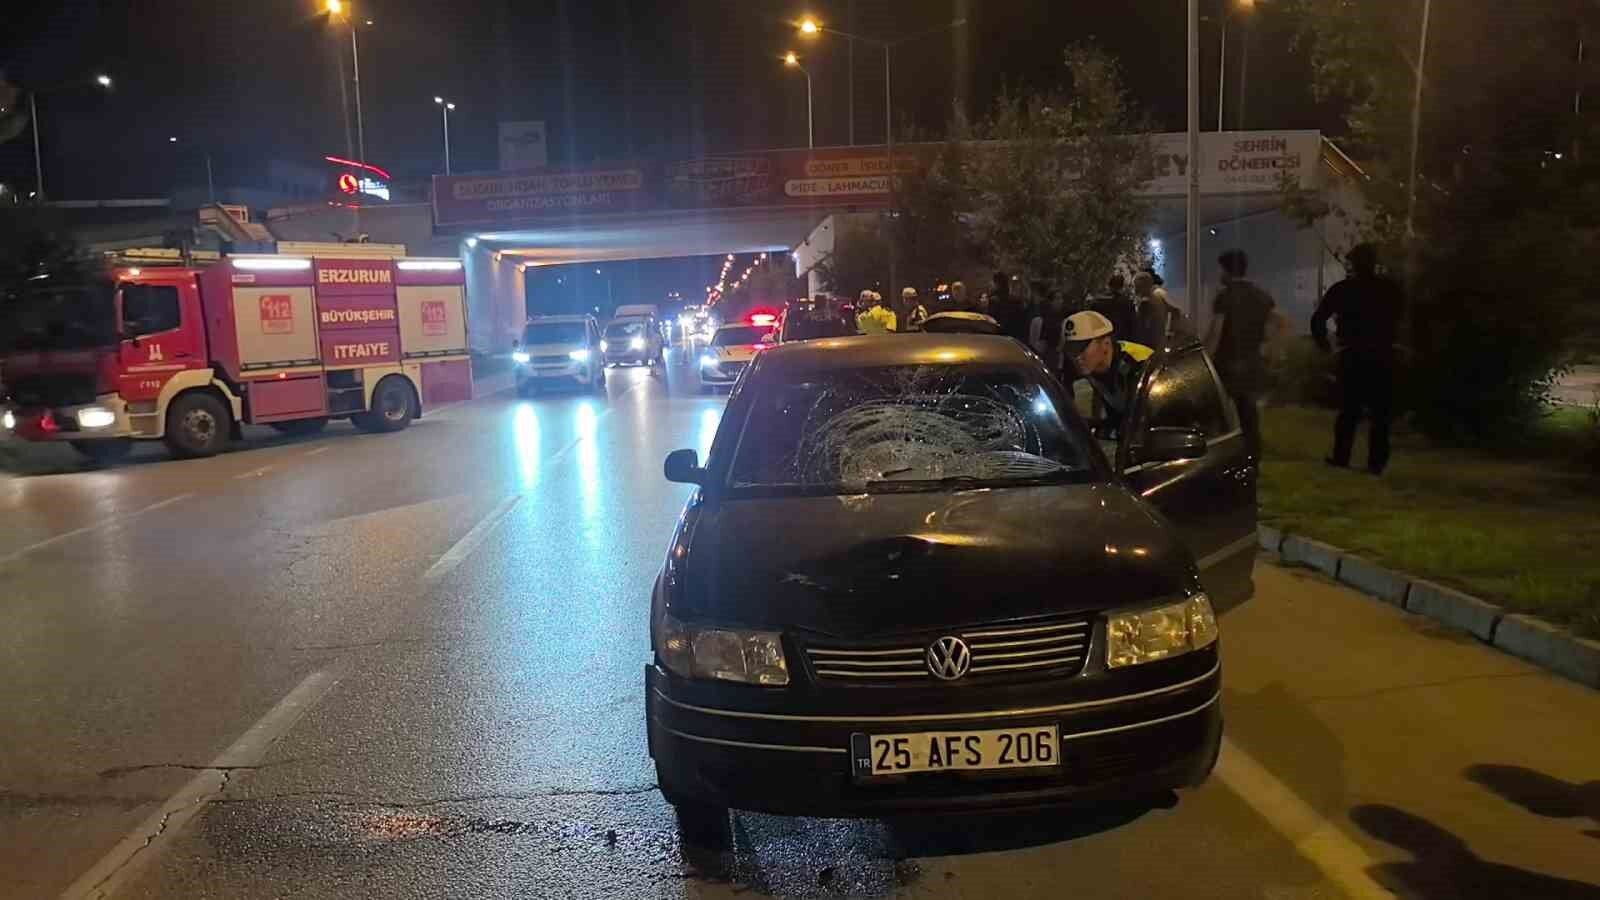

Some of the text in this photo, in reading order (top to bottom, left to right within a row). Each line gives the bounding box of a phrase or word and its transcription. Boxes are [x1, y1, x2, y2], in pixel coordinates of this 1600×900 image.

[318, 268, 392, 284] ERZURUM
[874, 732, 1052, 770] 25 AFS 206
[857, 758, 871, 769] TR
